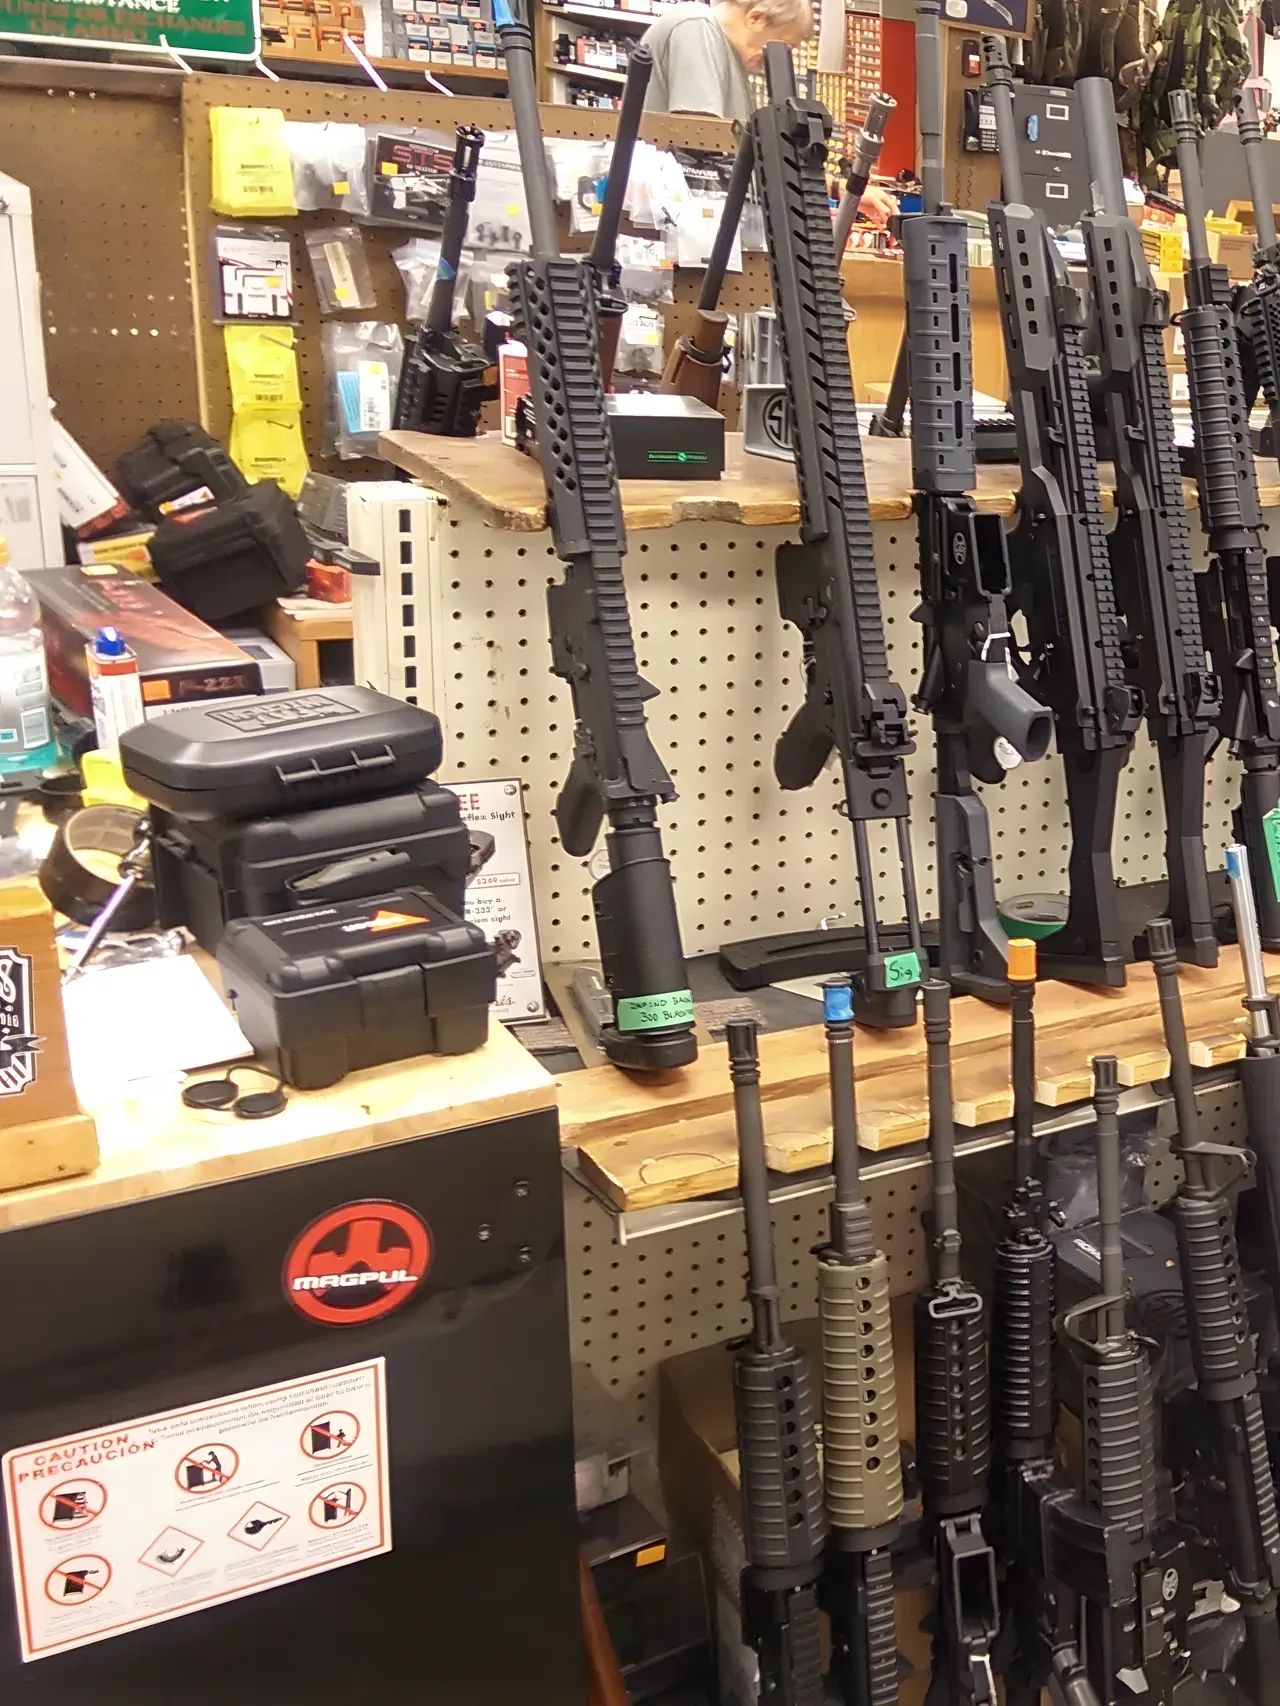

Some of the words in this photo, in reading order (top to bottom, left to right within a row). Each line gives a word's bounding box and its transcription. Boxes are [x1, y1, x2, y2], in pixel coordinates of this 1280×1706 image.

[889, 960, 913, 981] Sig
[293, 1269, 419, 1291] MAGPUL
[34, 1433, 130, 1466] CAUTION
